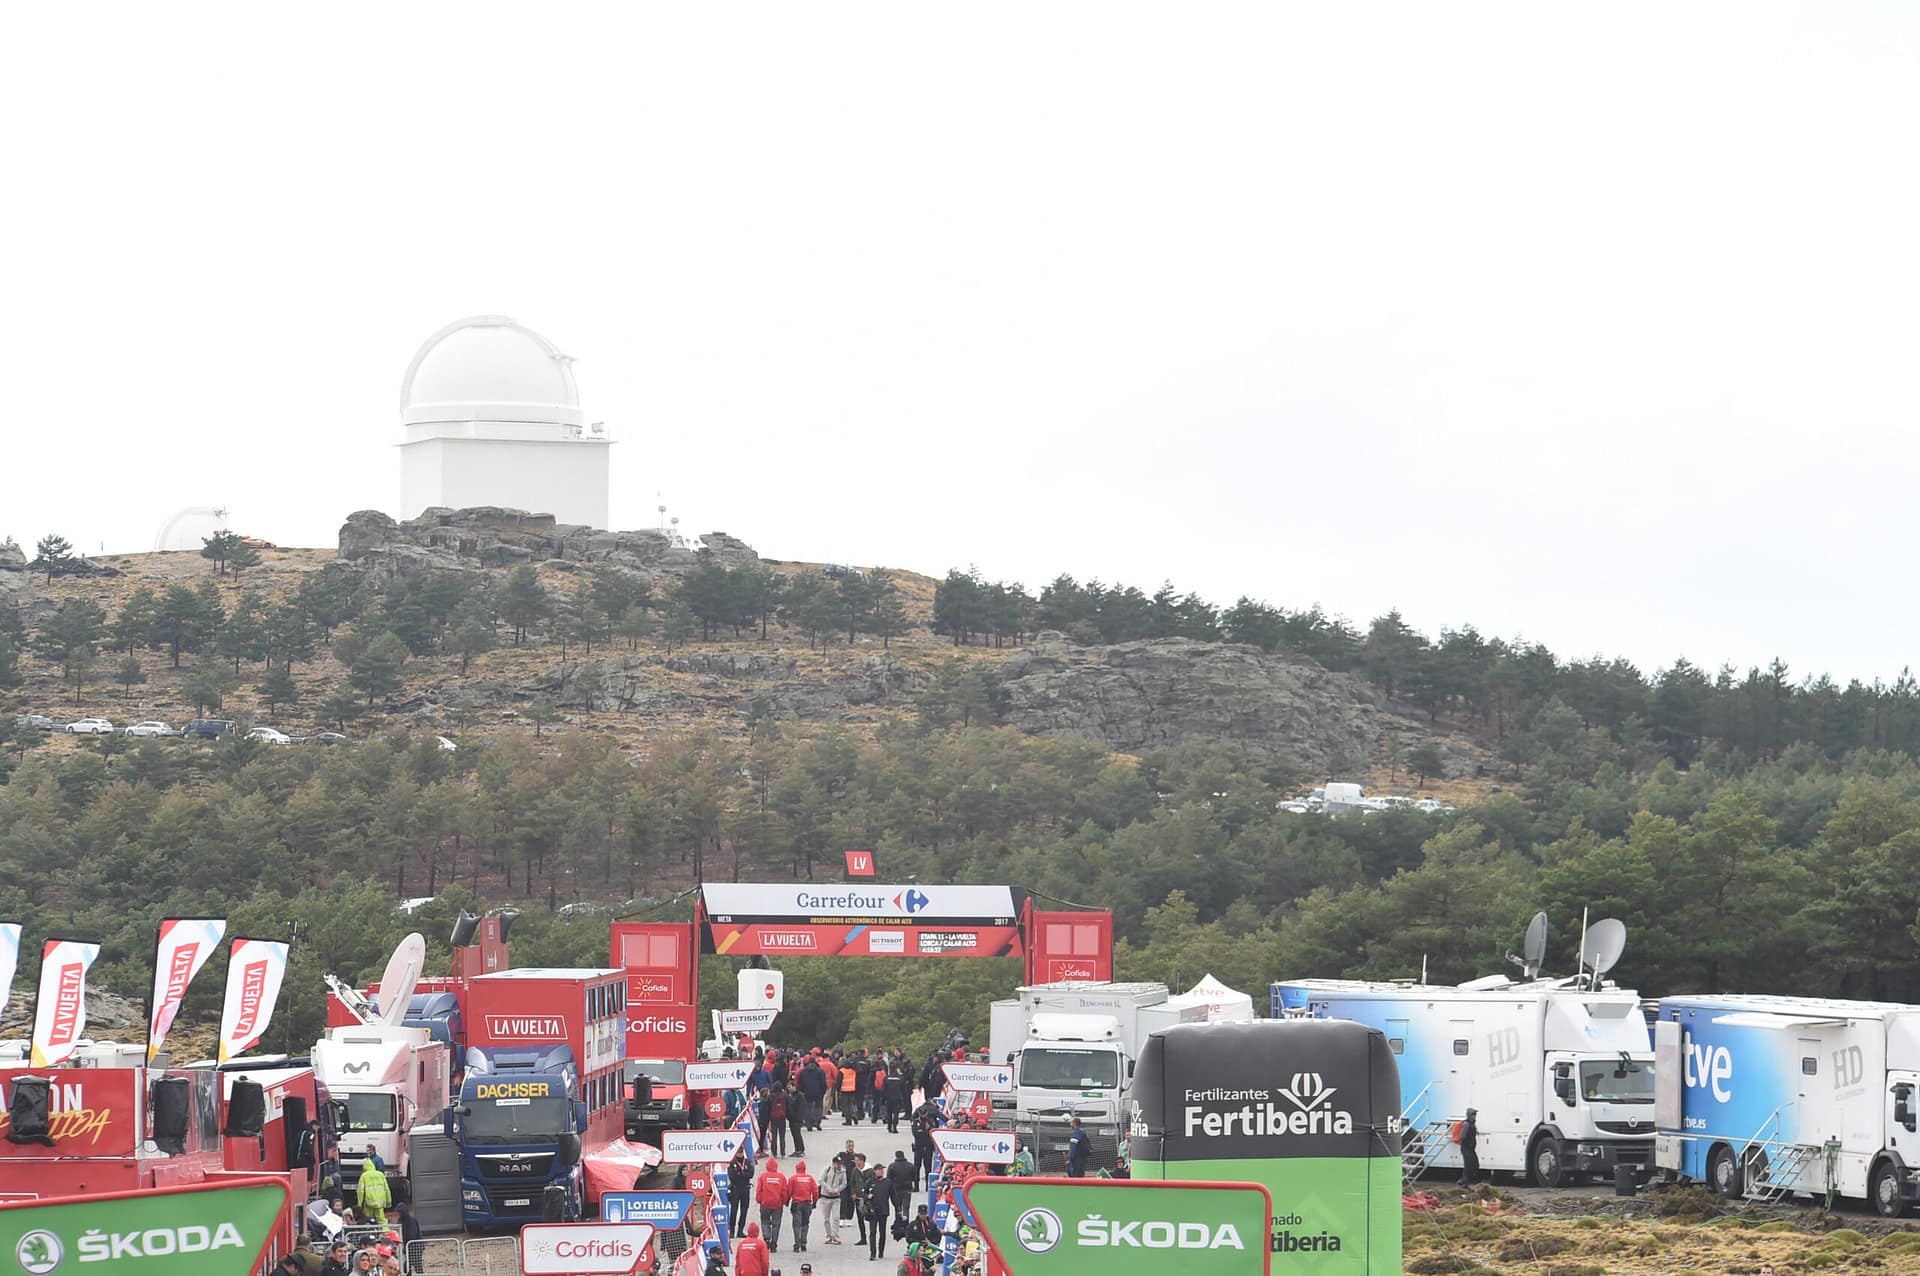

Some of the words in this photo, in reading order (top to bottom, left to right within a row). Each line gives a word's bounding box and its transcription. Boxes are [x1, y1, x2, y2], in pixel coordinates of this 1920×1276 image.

[853, 857, 867, 870] LV
[796, 892, 885, 908] Carrefour
[994, 918, 1009, 926] 2017
[764, 935, 775, 945] LA
[776, 935, 811, 946] VUELTA
[59, 969, 81, 1021] VUELTA
[241, 967, 263, 1016] VUELTA
[642, 984, 669, 992] Cofidis
[54, 1021, 72, 1039] LA
[494, 1020, 510, 1035] LA
[511, 1020, 560, 1035] VUELTA
[1487, 1026, 1520, 1068] HD
[1832, 1045, 1863, 1089] HD
[689, 1071, 727, 1080] Carrefour
[951, 1073, 990, 1082] Carrefour
[477, 1083, 549, 1099] DACHSER
[1185, 1087, 1269, 1102] Fertilizantes
[709, 1104, 721, 1112] 25
[975, 1105, 988, 1114] 25
[1184, 1102, 1353, 1137] Fertiberia
[668, 1142, 713, 1151] Carrefour
[942, 1141, 988, 1151] Carrefour
[499, 1164, 532, 1172] MAN
[691, 1180, 704, 1189] 50
[627, 1199, 679, 1210] LOTERÍAS
[1077, 1214, 1245, 1250] ŠKODA
[78, 1222, 245, 1263] ŠKODA
[556, 1240, 633, 1258] Cofidis
